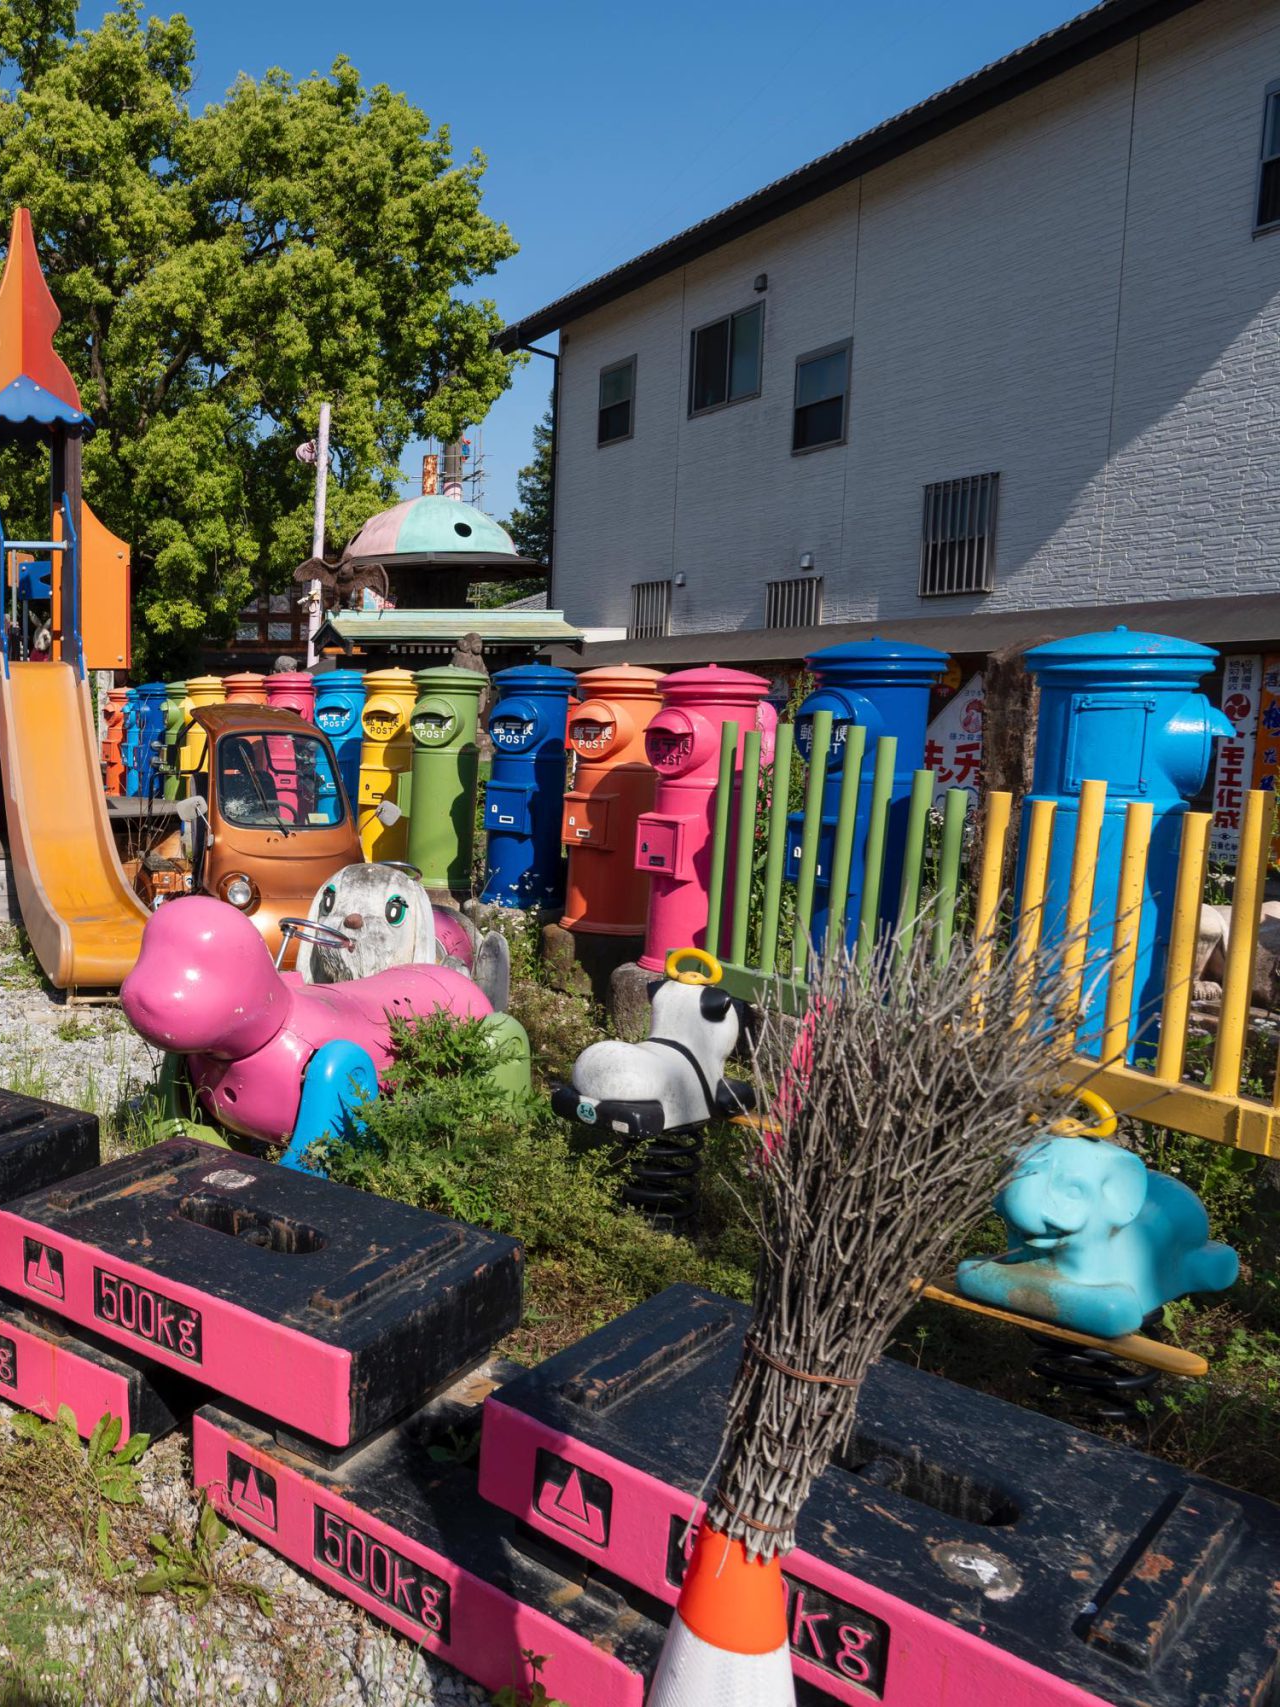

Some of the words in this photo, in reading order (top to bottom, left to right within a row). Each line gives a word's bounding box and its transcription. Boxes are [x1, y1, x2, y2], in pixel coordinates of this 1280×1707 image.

[370, 726, 394, 735] POST
[420, 730, 446, 739] POST
[499, 735, 527, 745] POST
[578, 739, 606, 749] POST
[806, 743, 842, 755] PT
[654, 754, 682, 766] POST
[100, 1273, 198, 1360] 500kg
[323, 1510, 443, 1632] 500kg
